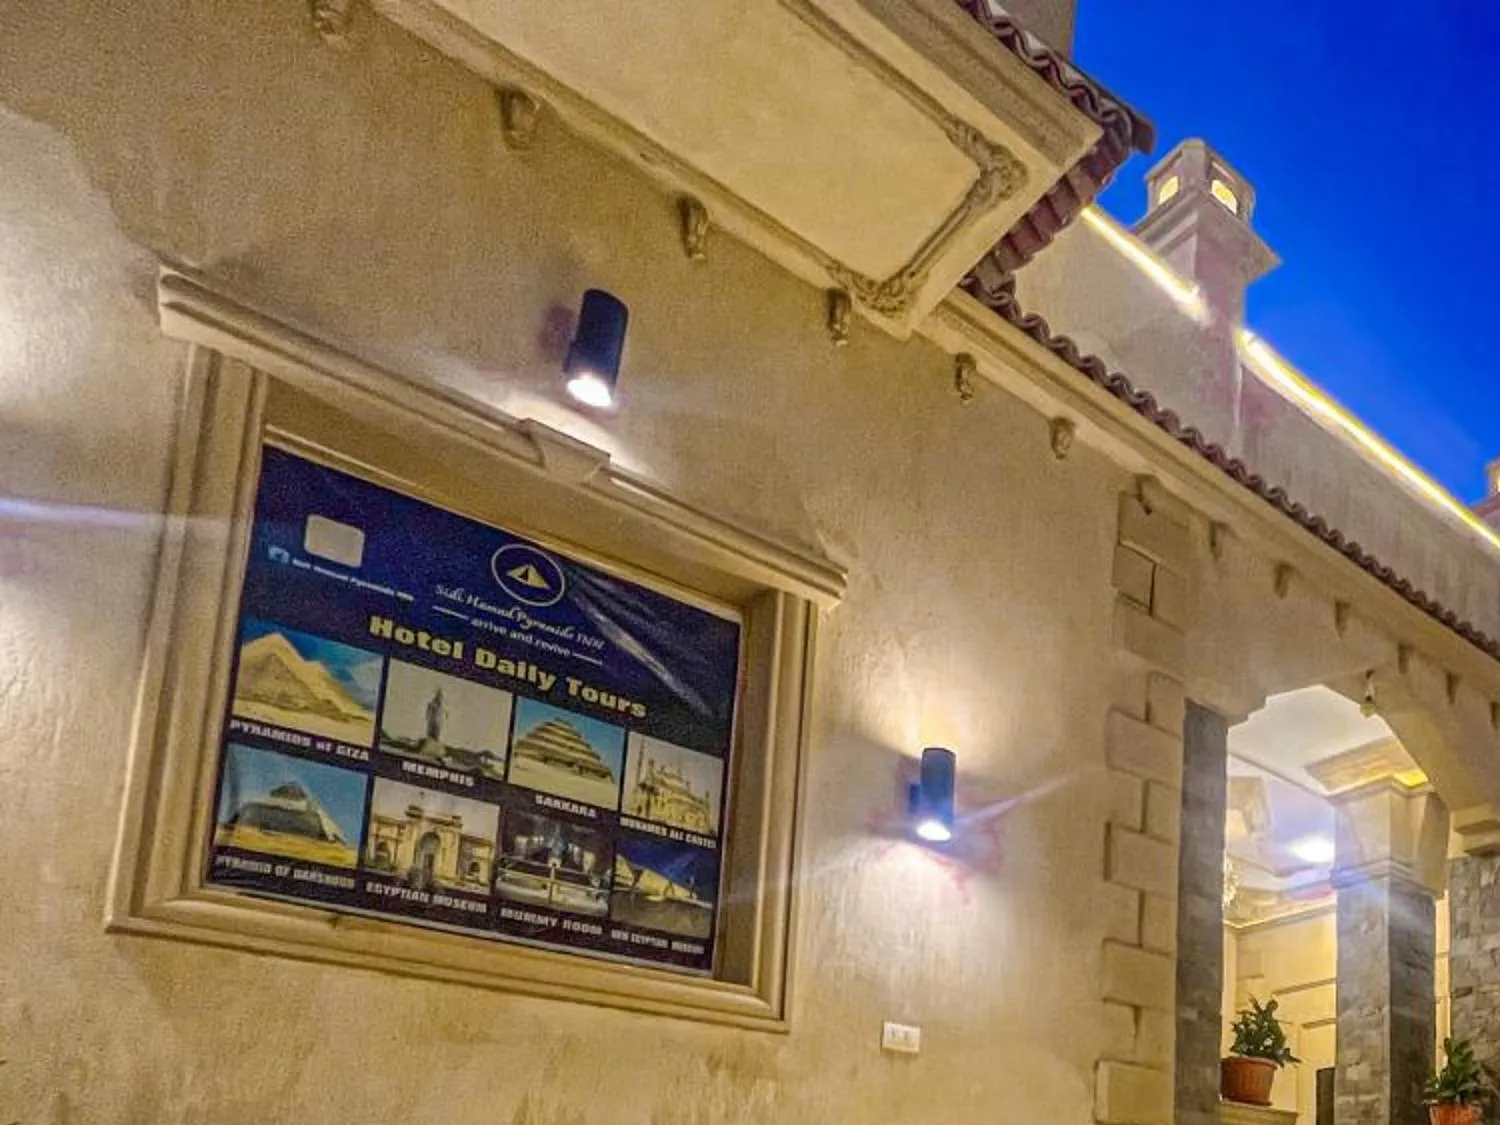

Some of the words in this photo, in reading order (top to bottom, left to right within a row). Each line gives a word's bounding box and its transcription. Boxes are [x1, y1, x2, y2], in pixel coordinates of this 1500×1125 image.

[509, 629, 534, 645] and
[369, 615, 463, 660] Hotel
[474, 647, 556, 691] Daily
[564, 676, 647, 719] Tours
[229, 719, 312, 747] PYRAMIDS
[336, 744, 370, 761] GIZA
[402, 760, 475, 788] MEMPHIS
[366, 881, 430, 904] EGYPTIAN
[433, 894, 487, 913] MUSEUM
[501, 907, 558, 928] MUMMY
[563, 919, 603, 935] ROOM
